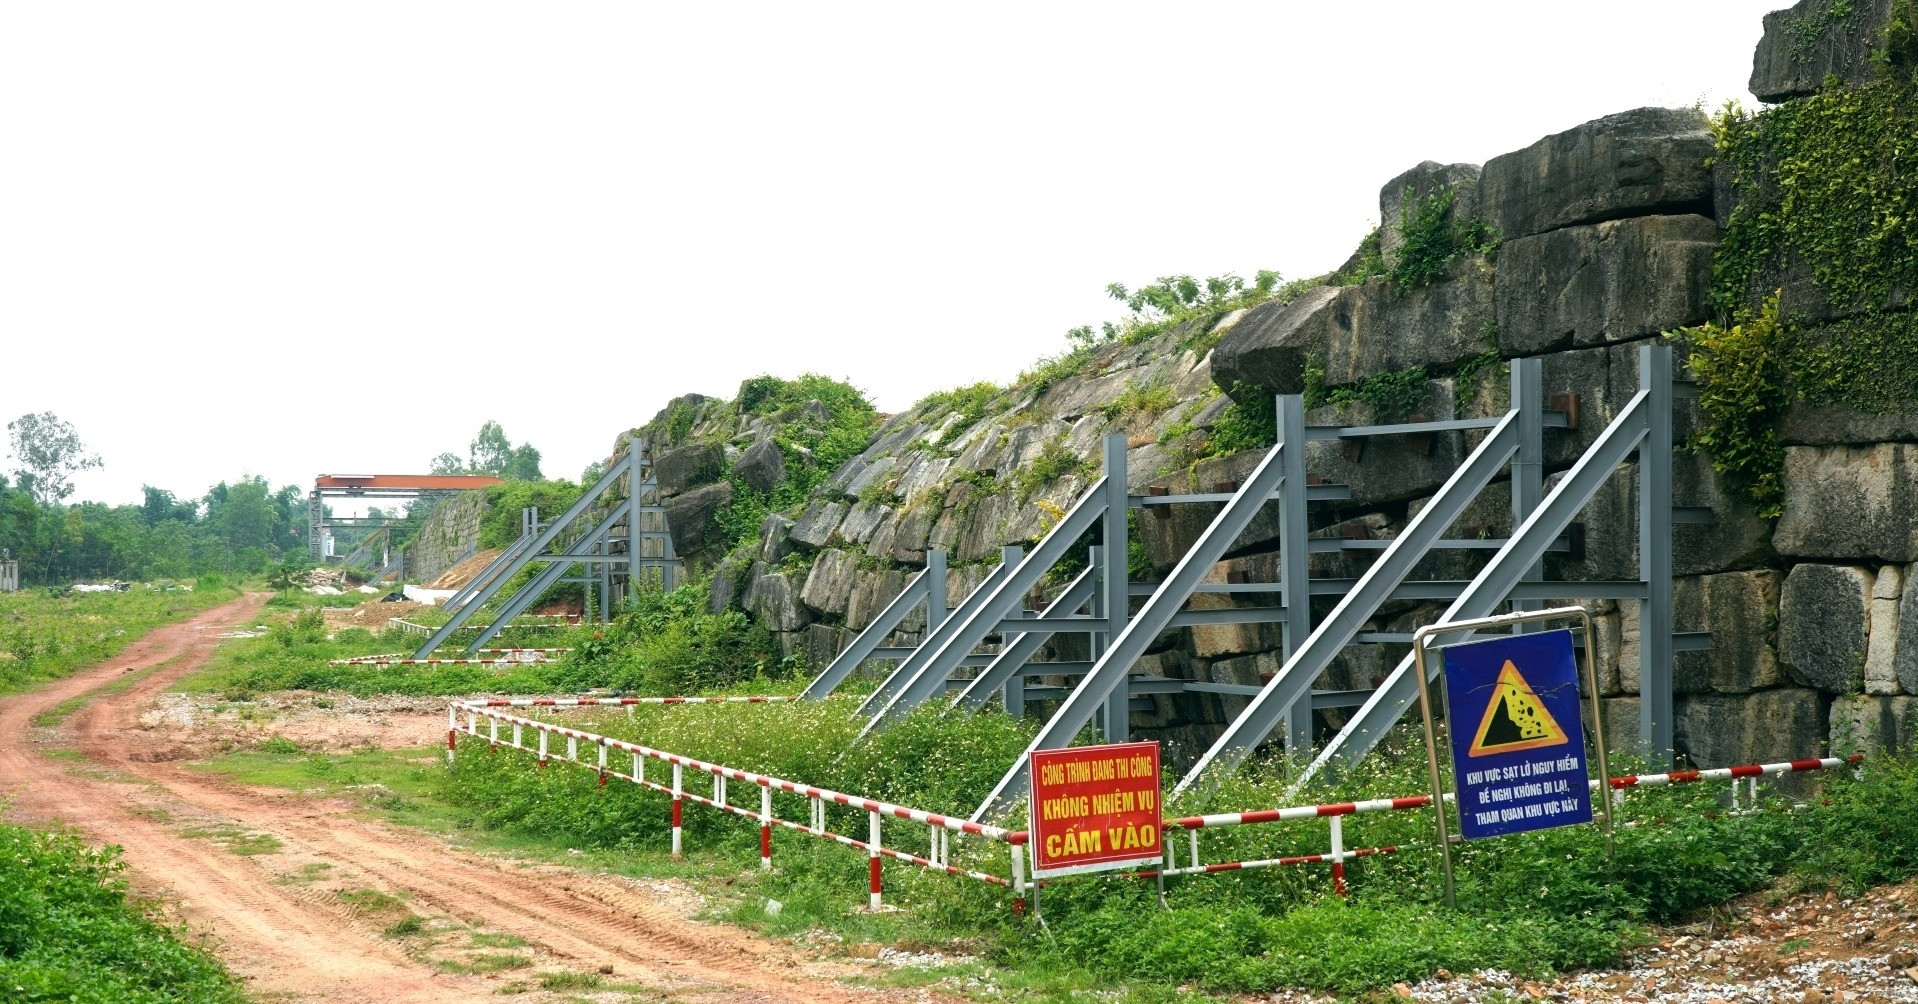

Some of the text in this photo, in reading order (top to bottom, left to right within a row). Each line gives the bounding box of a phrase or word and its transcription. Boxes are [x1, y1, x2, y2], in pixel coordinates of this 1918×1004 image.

[1042, 753, 1152, 786] CÔNG TRÌNH ĐANG THI CÔNG
[1467, 754, 1578, 785] KHU VỰC SẠT LỞ NGUY HIỂM
[1043, 789, 1154, 820] KHÔNG NHIỆM VỤ
[1492, 787, 1513, 802] NGHỊ
[1514, 783, 1542, 798] KHÔNG
[1544, 782, 1552, 794] ĐI
[1476, 797, 1578, 825] THAM QUAN KHU VỰC NÀY
[1046, 822, 1155, 857] CẤM VÀO
